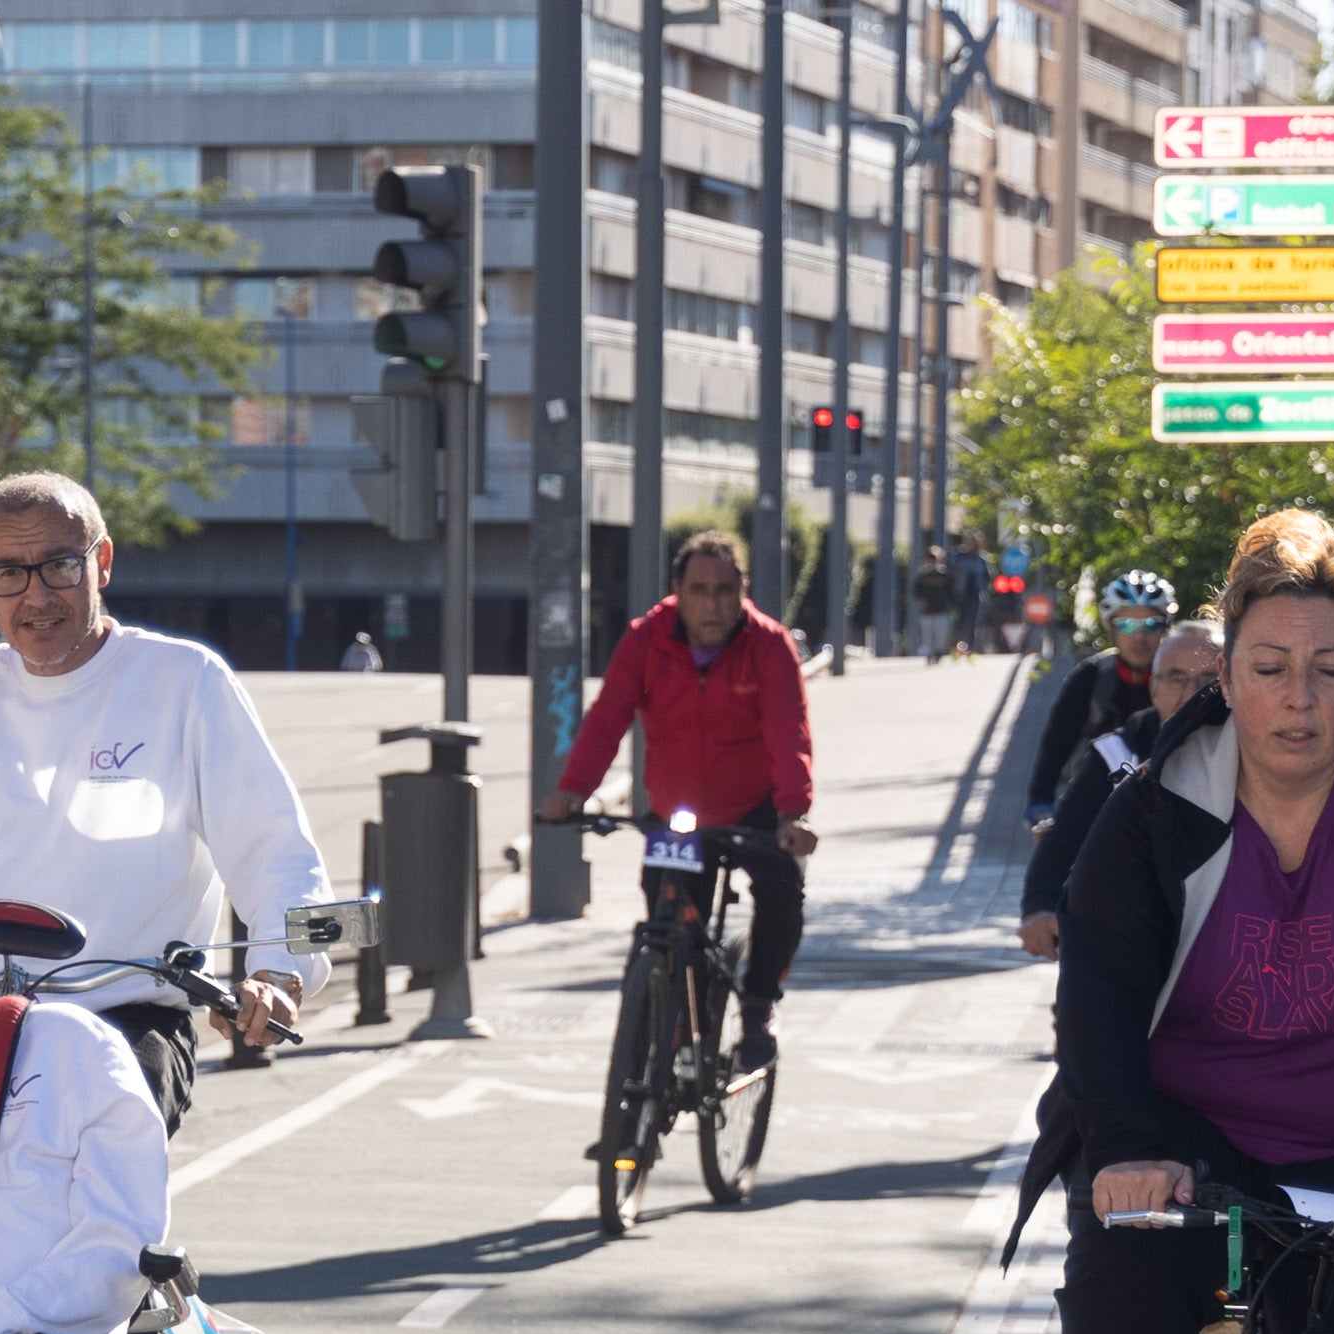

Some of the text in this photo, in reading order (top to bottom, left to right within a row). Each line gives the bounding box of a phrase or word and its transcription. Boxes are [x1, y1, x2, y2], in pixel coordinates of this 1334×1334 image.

[1161, 257, 1235, 272] oficina
[1249, 257, 1276, 272] de
[652, 841, 696, 861] 314
[1230, 913, 1334, 959] RISE
